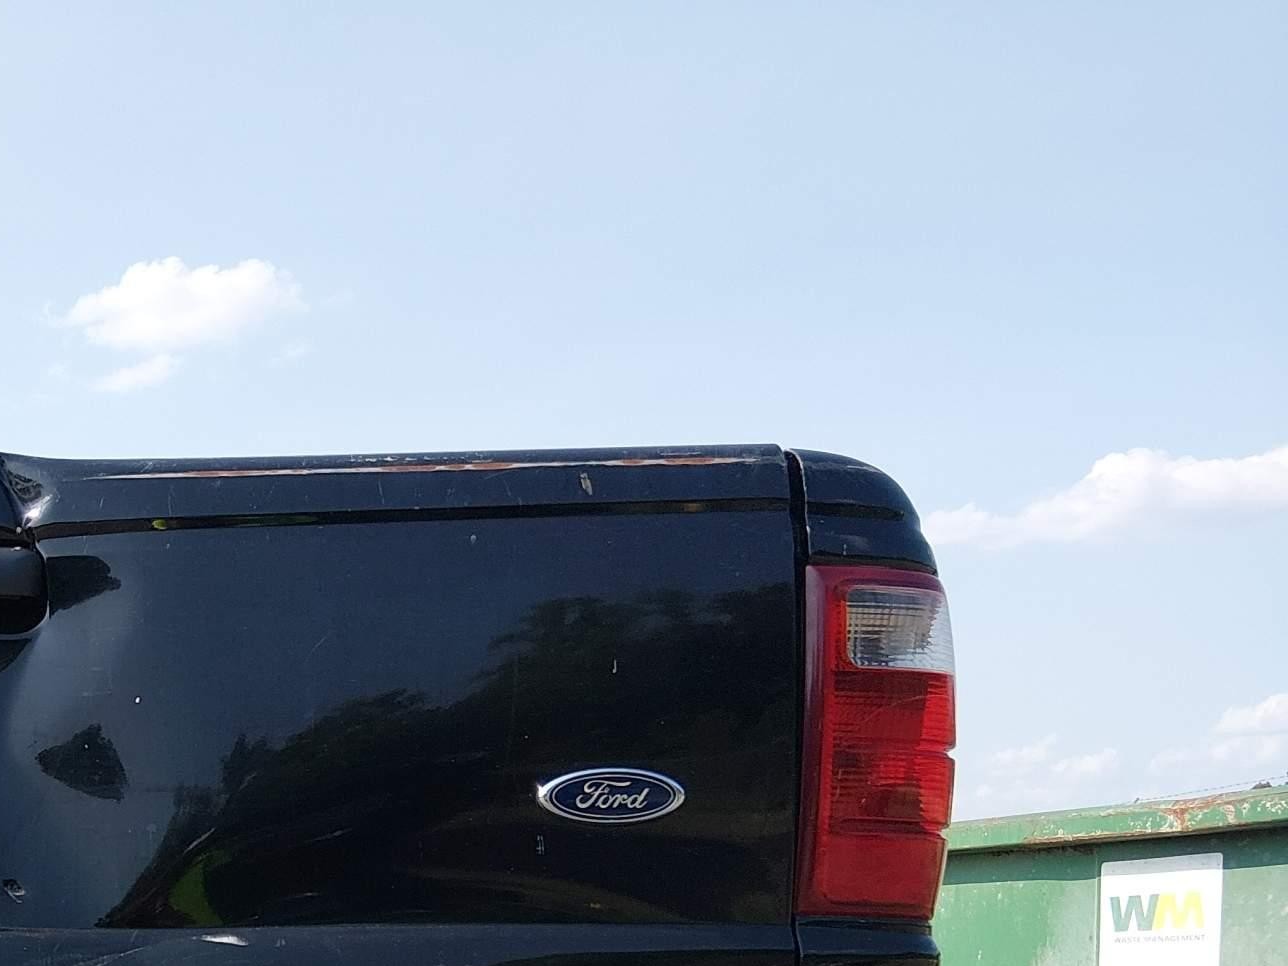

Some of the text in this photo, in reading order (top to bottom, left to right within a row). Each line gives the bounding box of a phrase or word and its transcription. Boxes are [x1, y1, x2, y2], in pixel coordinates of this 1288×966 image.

[575, 779, 650, 809] Ford
[1110, 890, 1205, 933] WM
[1144, 934, 1205, 943] MANAGEMENT
